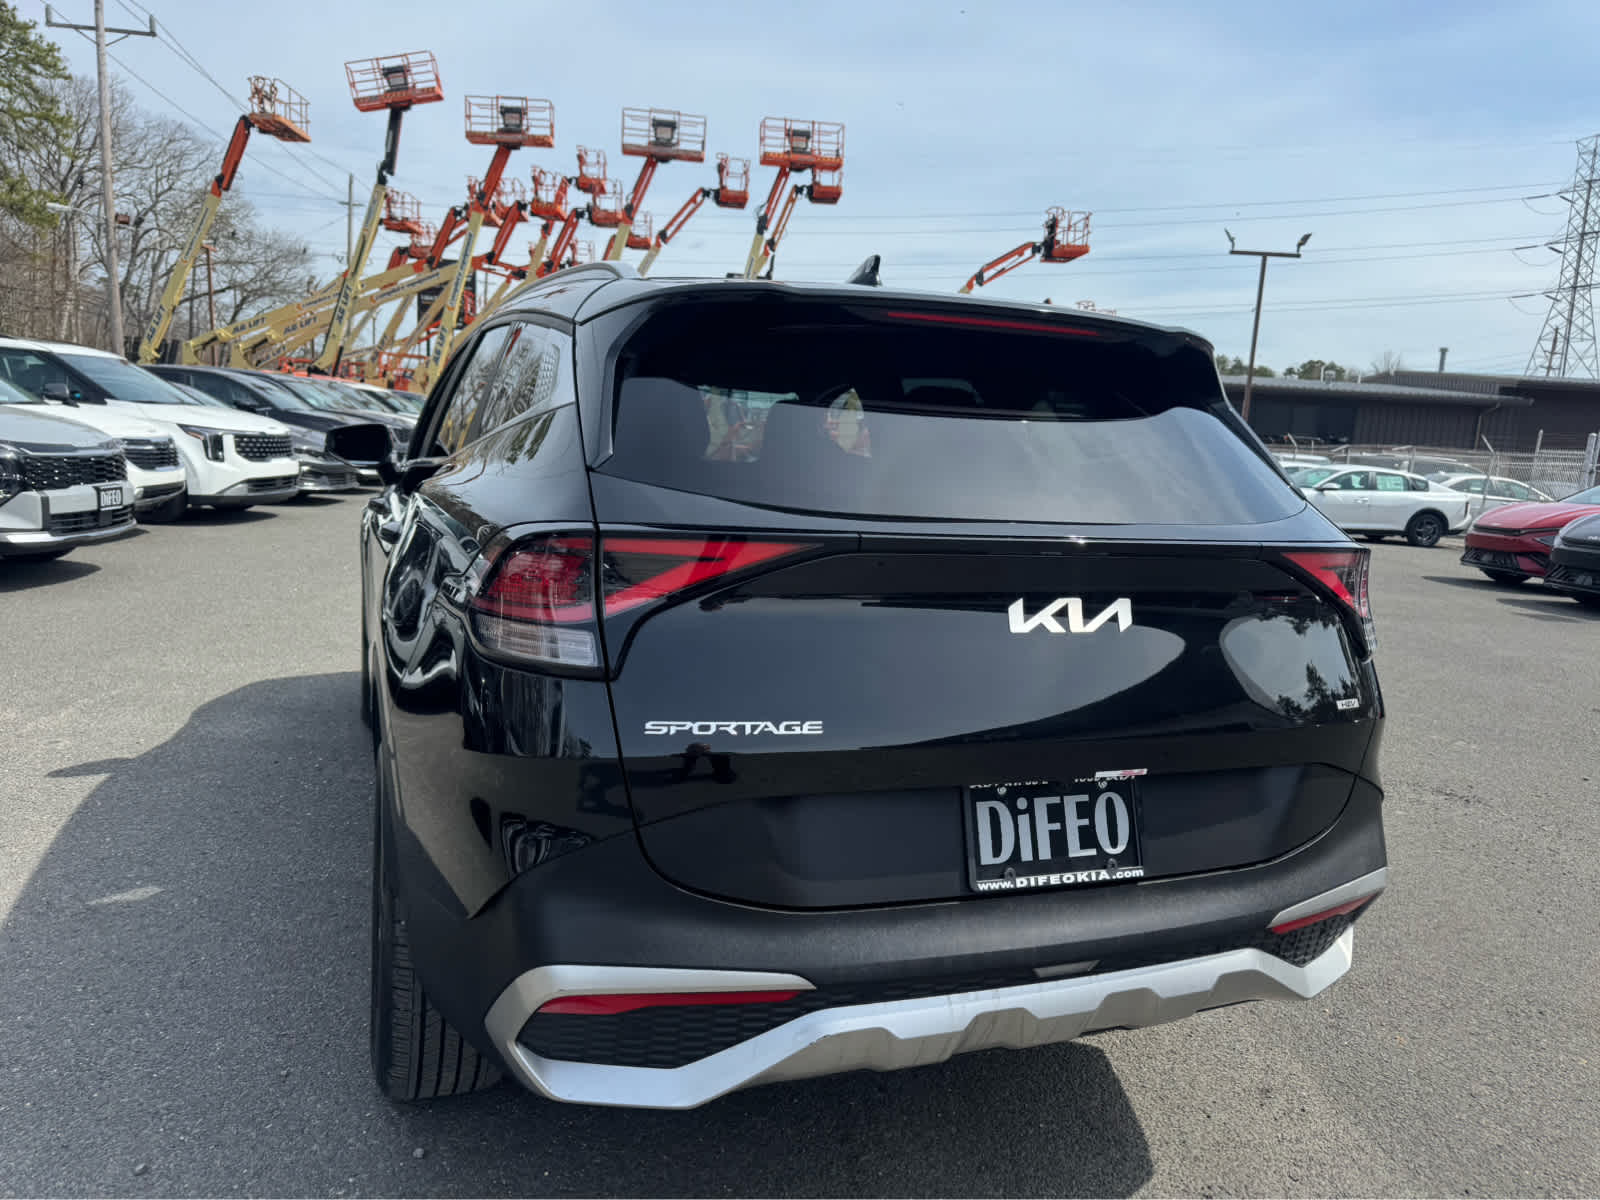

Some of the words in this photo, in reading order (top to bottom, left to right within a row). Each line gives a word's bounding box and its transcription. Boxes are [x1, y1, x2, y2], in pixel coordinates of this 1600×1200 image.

[248, 316, 266, 329] LIFT
[300, 314, 318, 327] LIFT
[1008, 597, 1133, 633] KIA
[644, 720, 824, 736] SPORTAGE
[975, 791, 1130, 865] DiFEO
[977, 867, 1144, 891] www.DIFEOKIA.com
